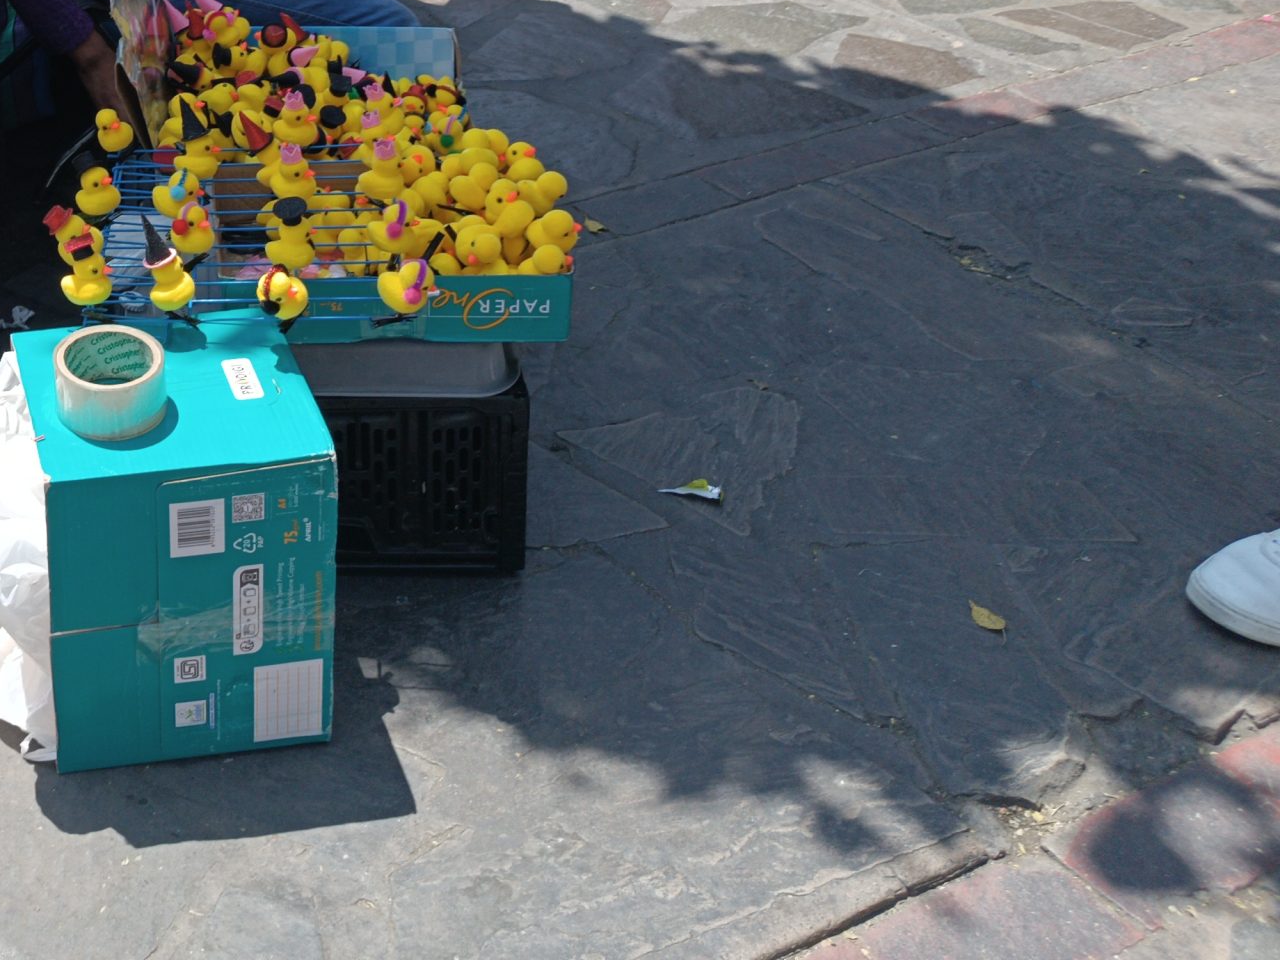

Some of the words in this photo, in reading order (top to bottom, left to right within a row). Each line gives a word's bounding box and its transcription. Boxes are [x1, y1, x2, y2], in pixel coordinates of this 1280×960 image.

[477, 299, 551, 314] PAPER
[243, 539, 251, 548] 20
[284, 531, 297, 544] 75
